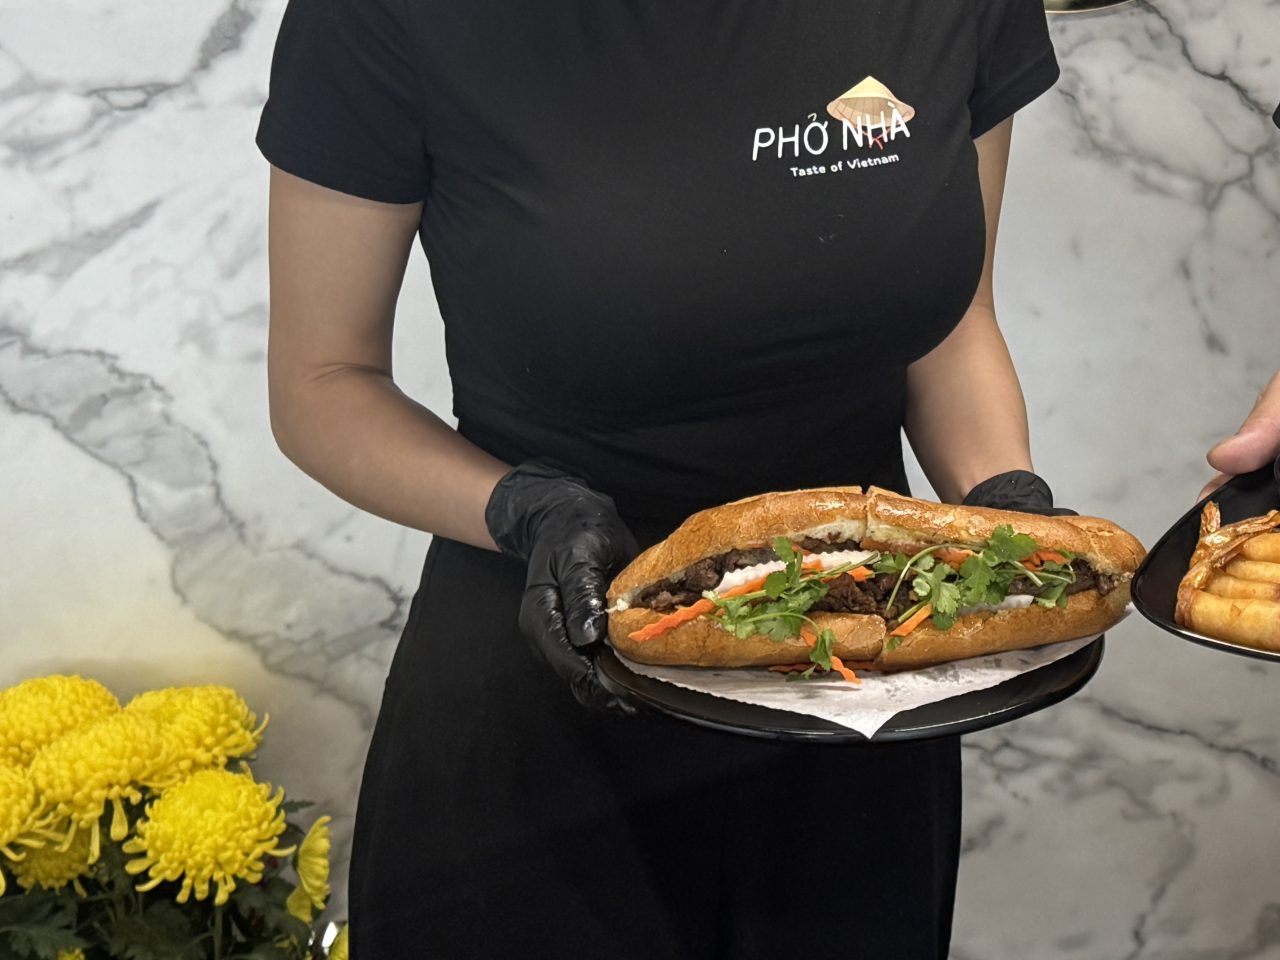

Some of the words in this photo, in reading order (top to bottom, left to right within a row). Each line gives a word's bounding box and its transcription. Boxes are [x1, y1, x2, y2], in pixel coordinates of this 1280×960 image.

[752, 112, 829, 161] PHỞ
[790, 163, 826, 177] Taste
[831, 161, 843, 173] of
[847, 153, 900, 169] Vietnam
